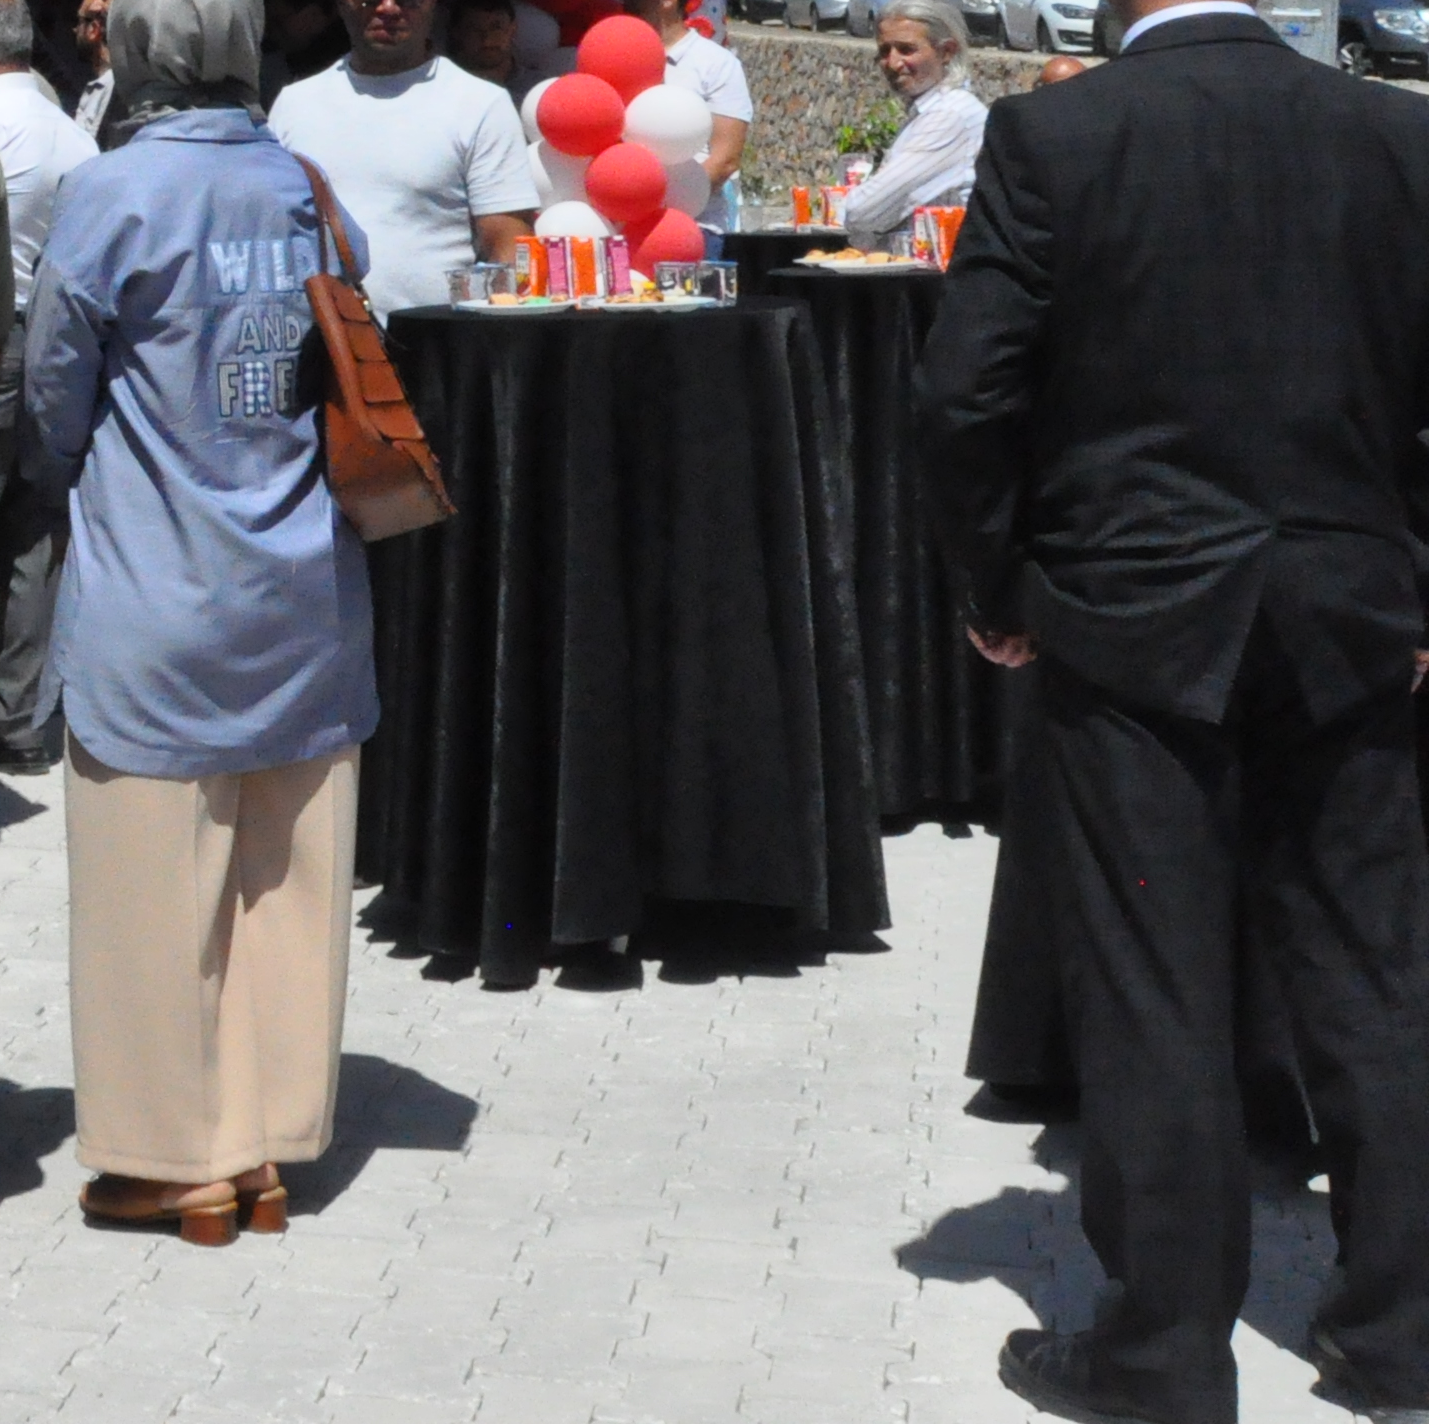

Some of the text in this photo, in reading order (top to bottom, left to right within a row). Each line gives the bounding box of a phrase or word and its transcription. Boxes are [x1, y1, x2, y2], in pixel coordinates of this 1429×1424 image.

[208, 236, 319, 295] WILD
[235, 315, 302, 355] AND
[217, 359, 298, 418] FRE
